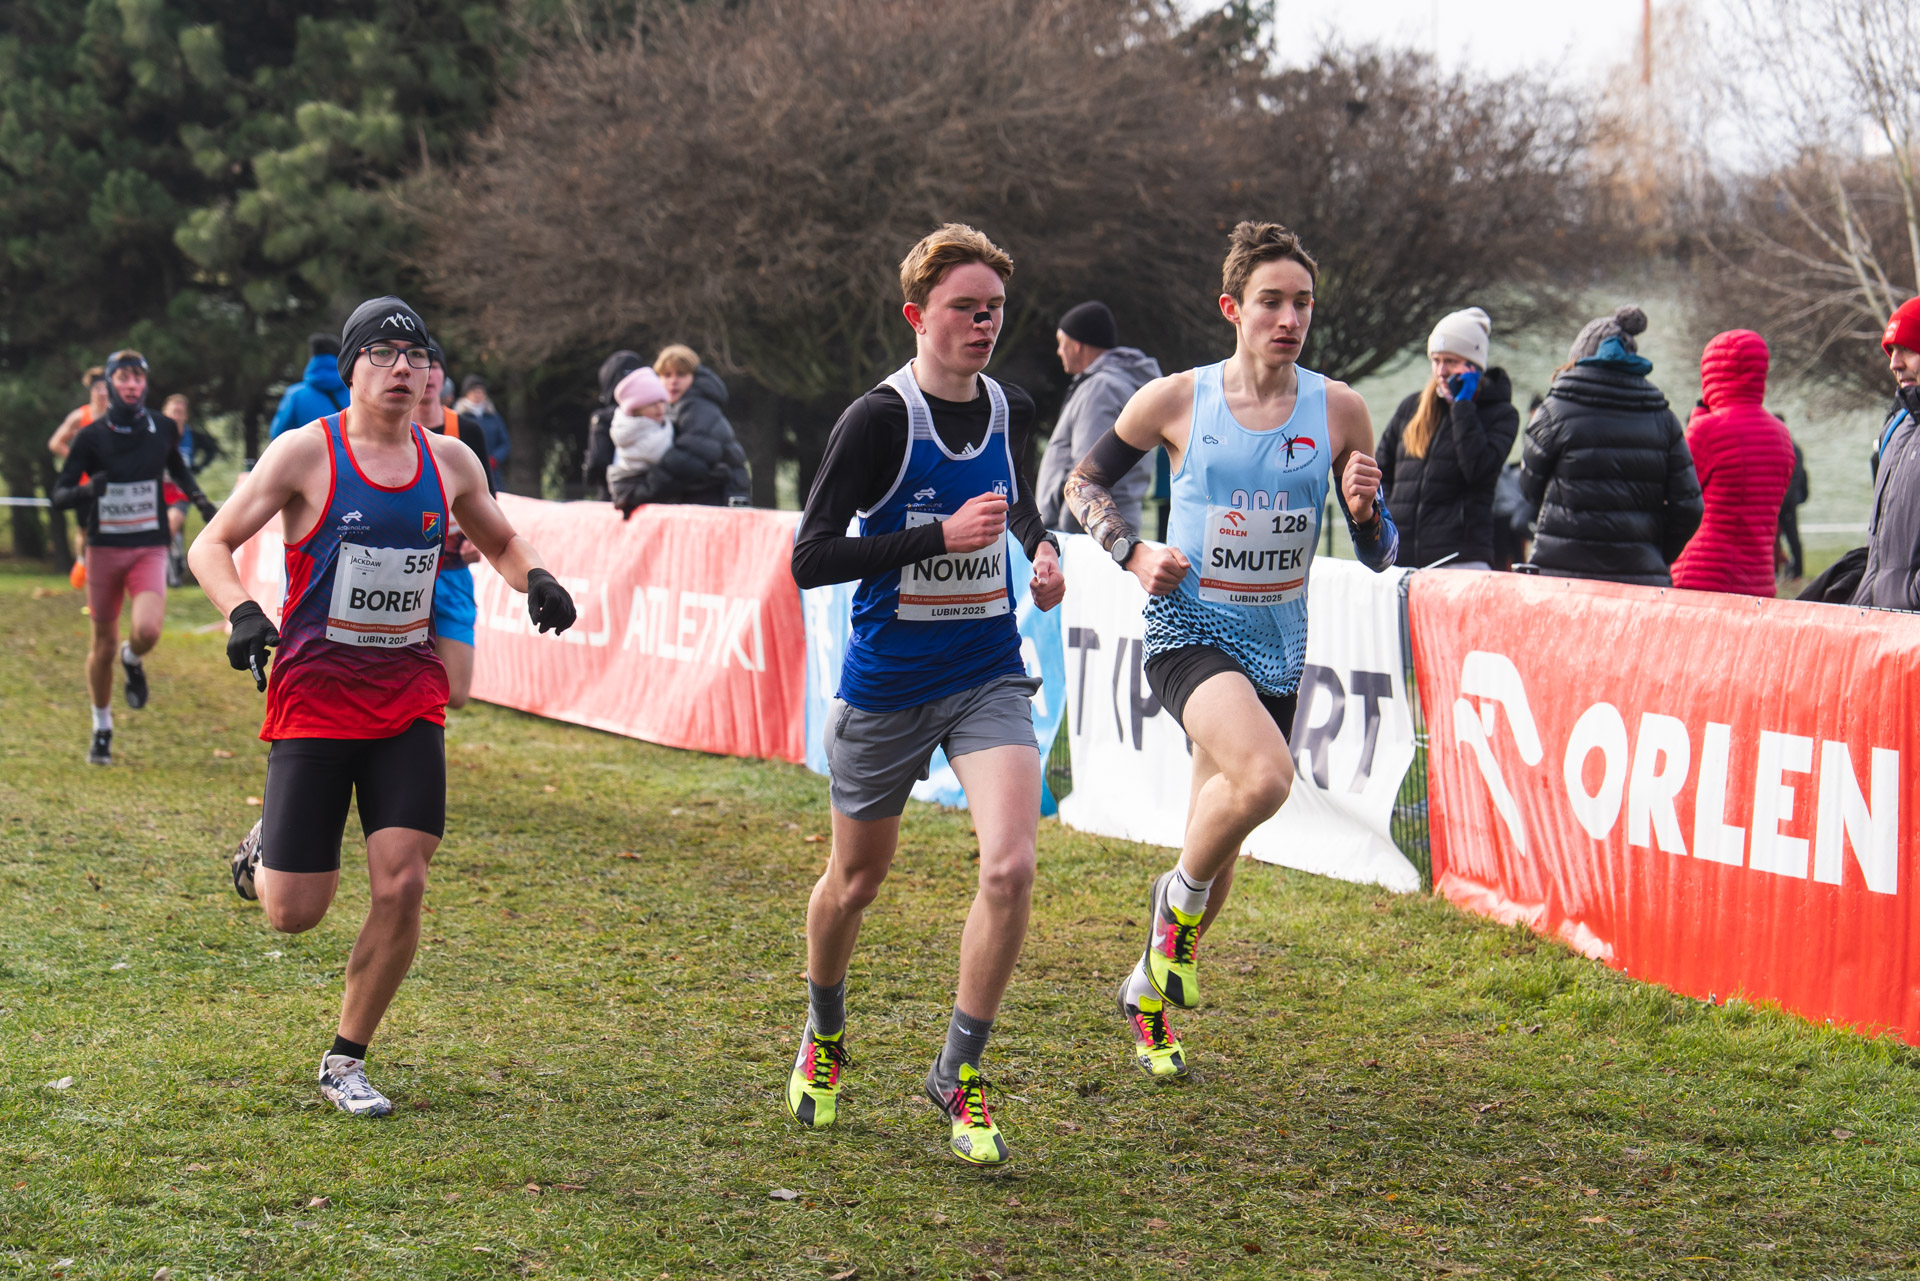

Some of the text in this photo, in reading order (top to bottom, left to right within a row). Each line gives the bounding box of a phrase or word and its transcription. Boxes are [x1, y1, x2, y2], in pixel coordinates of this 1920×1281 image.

[1219, 527, 1248, 537] ORLEN
[1271, 514, 1307, 534] 128
[350, 555, 382, 567] JACKDAW
[403, 553, 435, 574] 558
[913, 552, 1001, 582] NOWAK
[1210, 547, 1304, 571] SMUTEK
[349, 587, 425, 612] BOREK
[1229, 594, 1283, 603] LUBIN 2025
[931, 606, 986, 617] LUBIN 2025
[622, 585, 765, 672] ATLETYKI
[357, 635, 408, 645] LUBIN 2025
[1563, 701, 1899, 895] ORLEN
